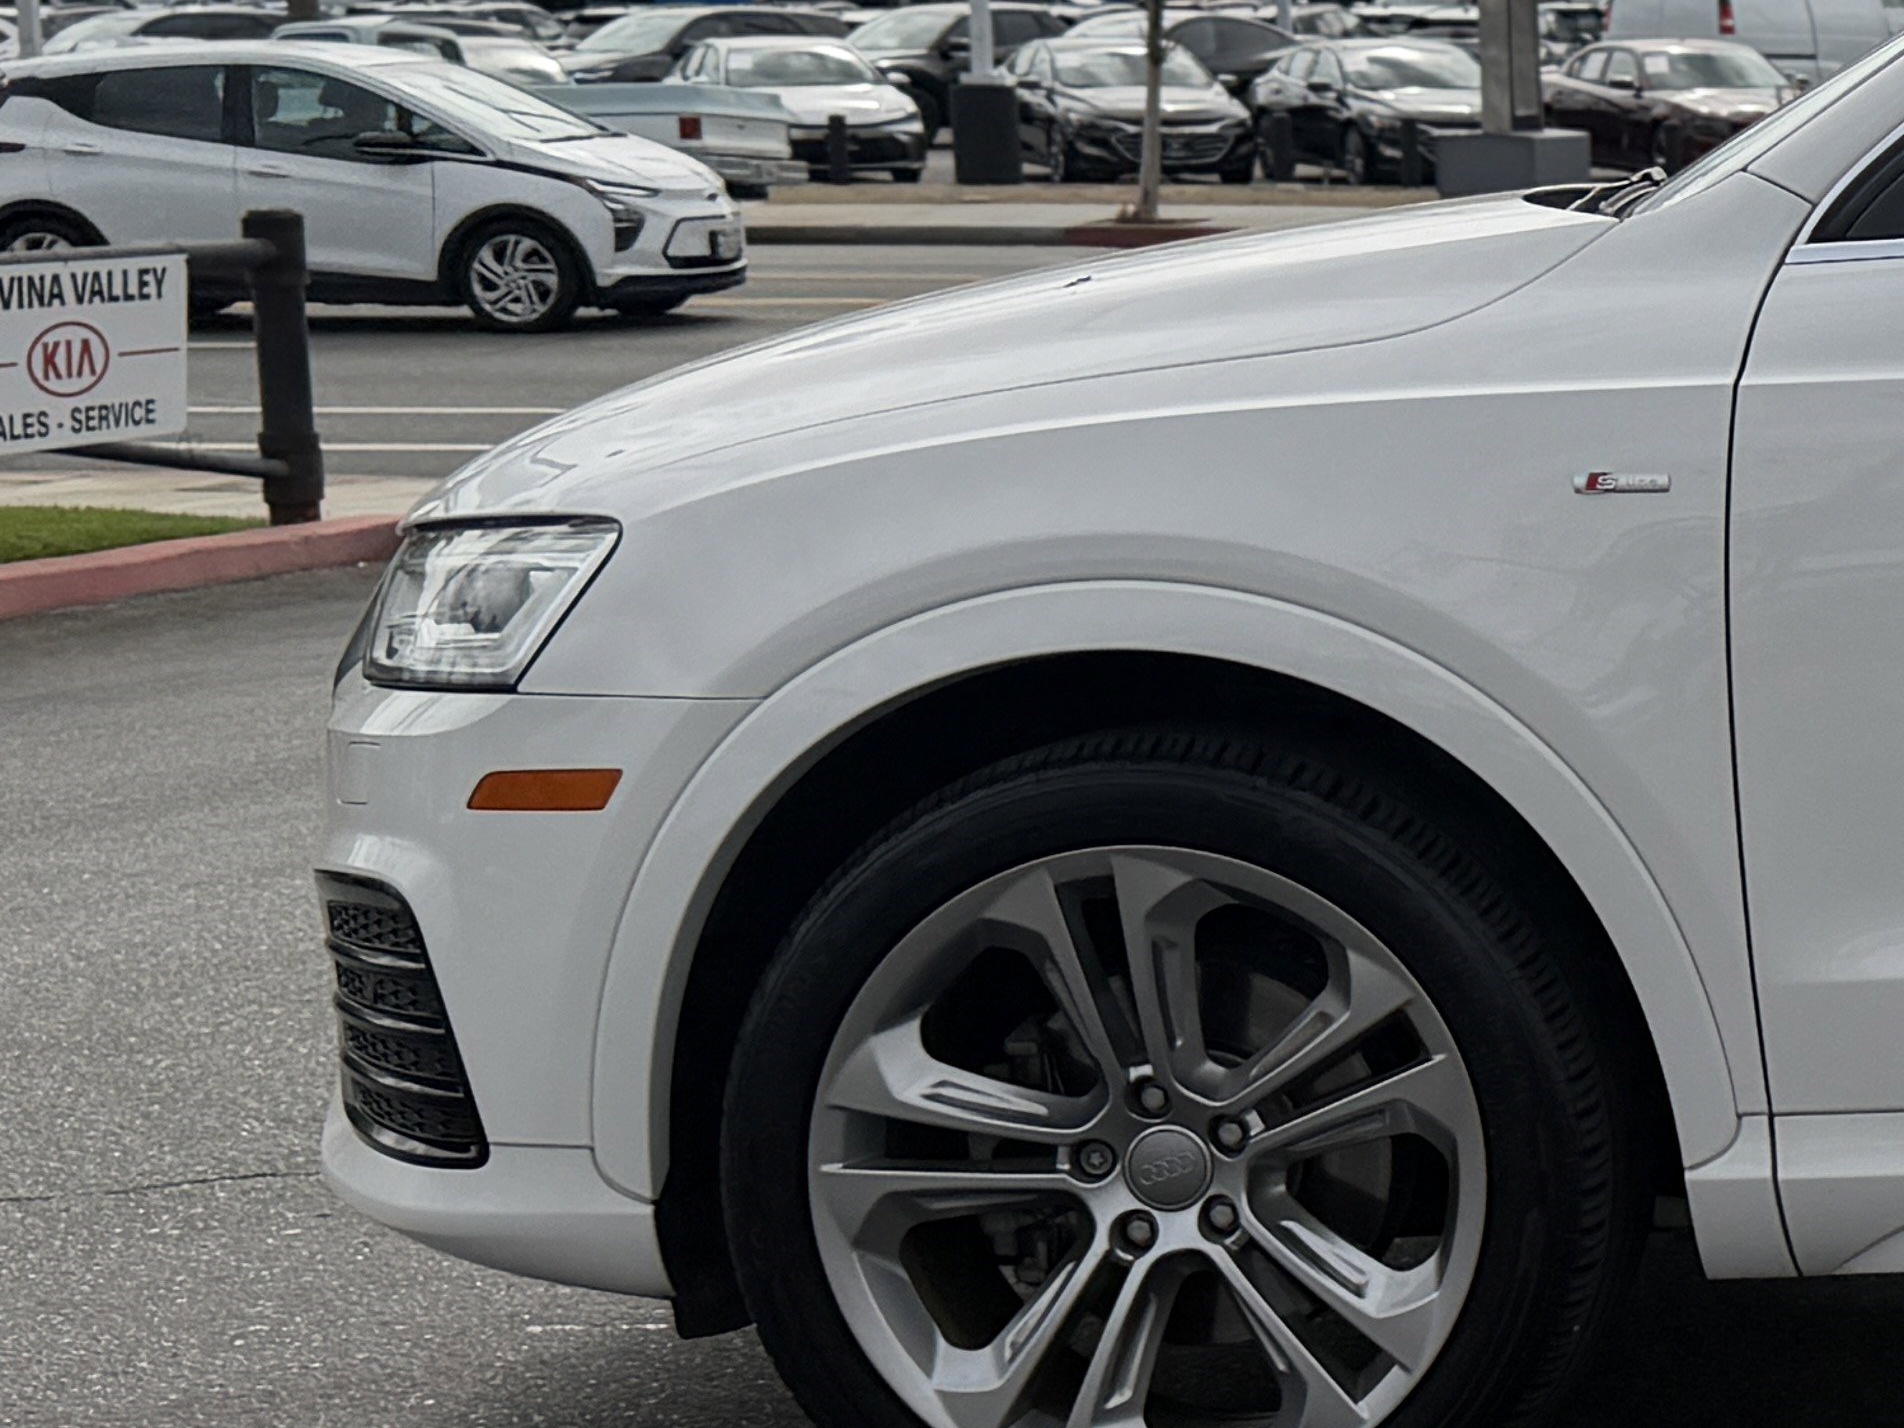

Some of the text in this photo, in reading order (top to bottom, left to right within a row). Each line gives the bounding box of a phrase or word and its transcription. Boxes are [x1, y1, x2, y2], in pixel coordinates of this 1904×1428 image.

[70, 266, 168, 308] VALLEY
[42, 338, 98, 382] KIA
[70, 398, 157, 434] SERVICE
